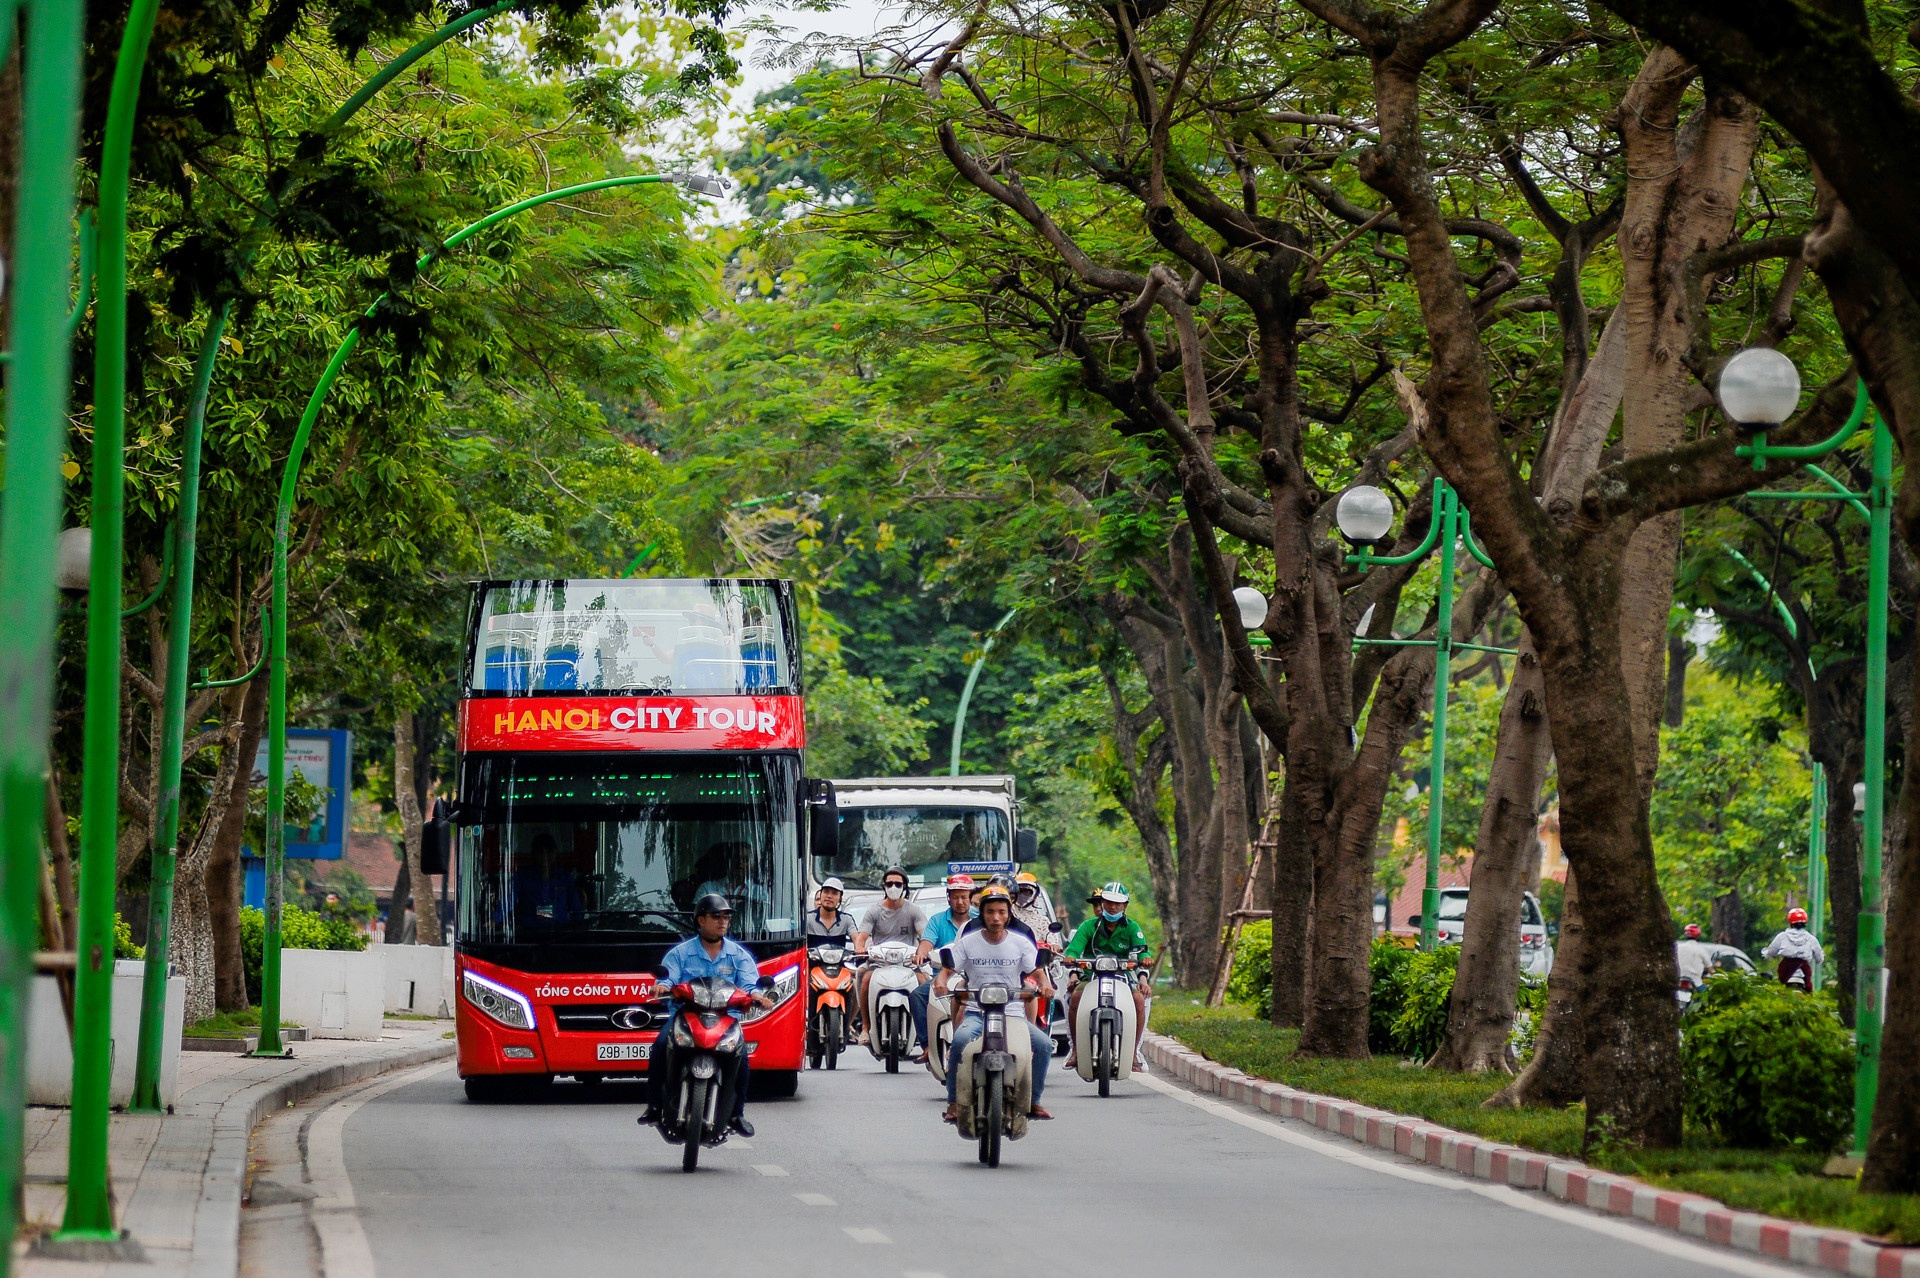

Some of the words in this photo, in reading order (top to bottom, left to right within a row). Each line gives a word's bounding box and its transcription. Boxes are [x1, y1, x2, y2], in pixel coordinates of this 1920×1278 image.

[494, 708, 599, 735] HANOI
[609, 707, 683, 730] CITY
[692, 707, 777, 736] TOUR
[535, 982, 570, 998] TỔNG
[572, 983, 611, 996] CÔNG
[614, 985, 627, 996] TY
